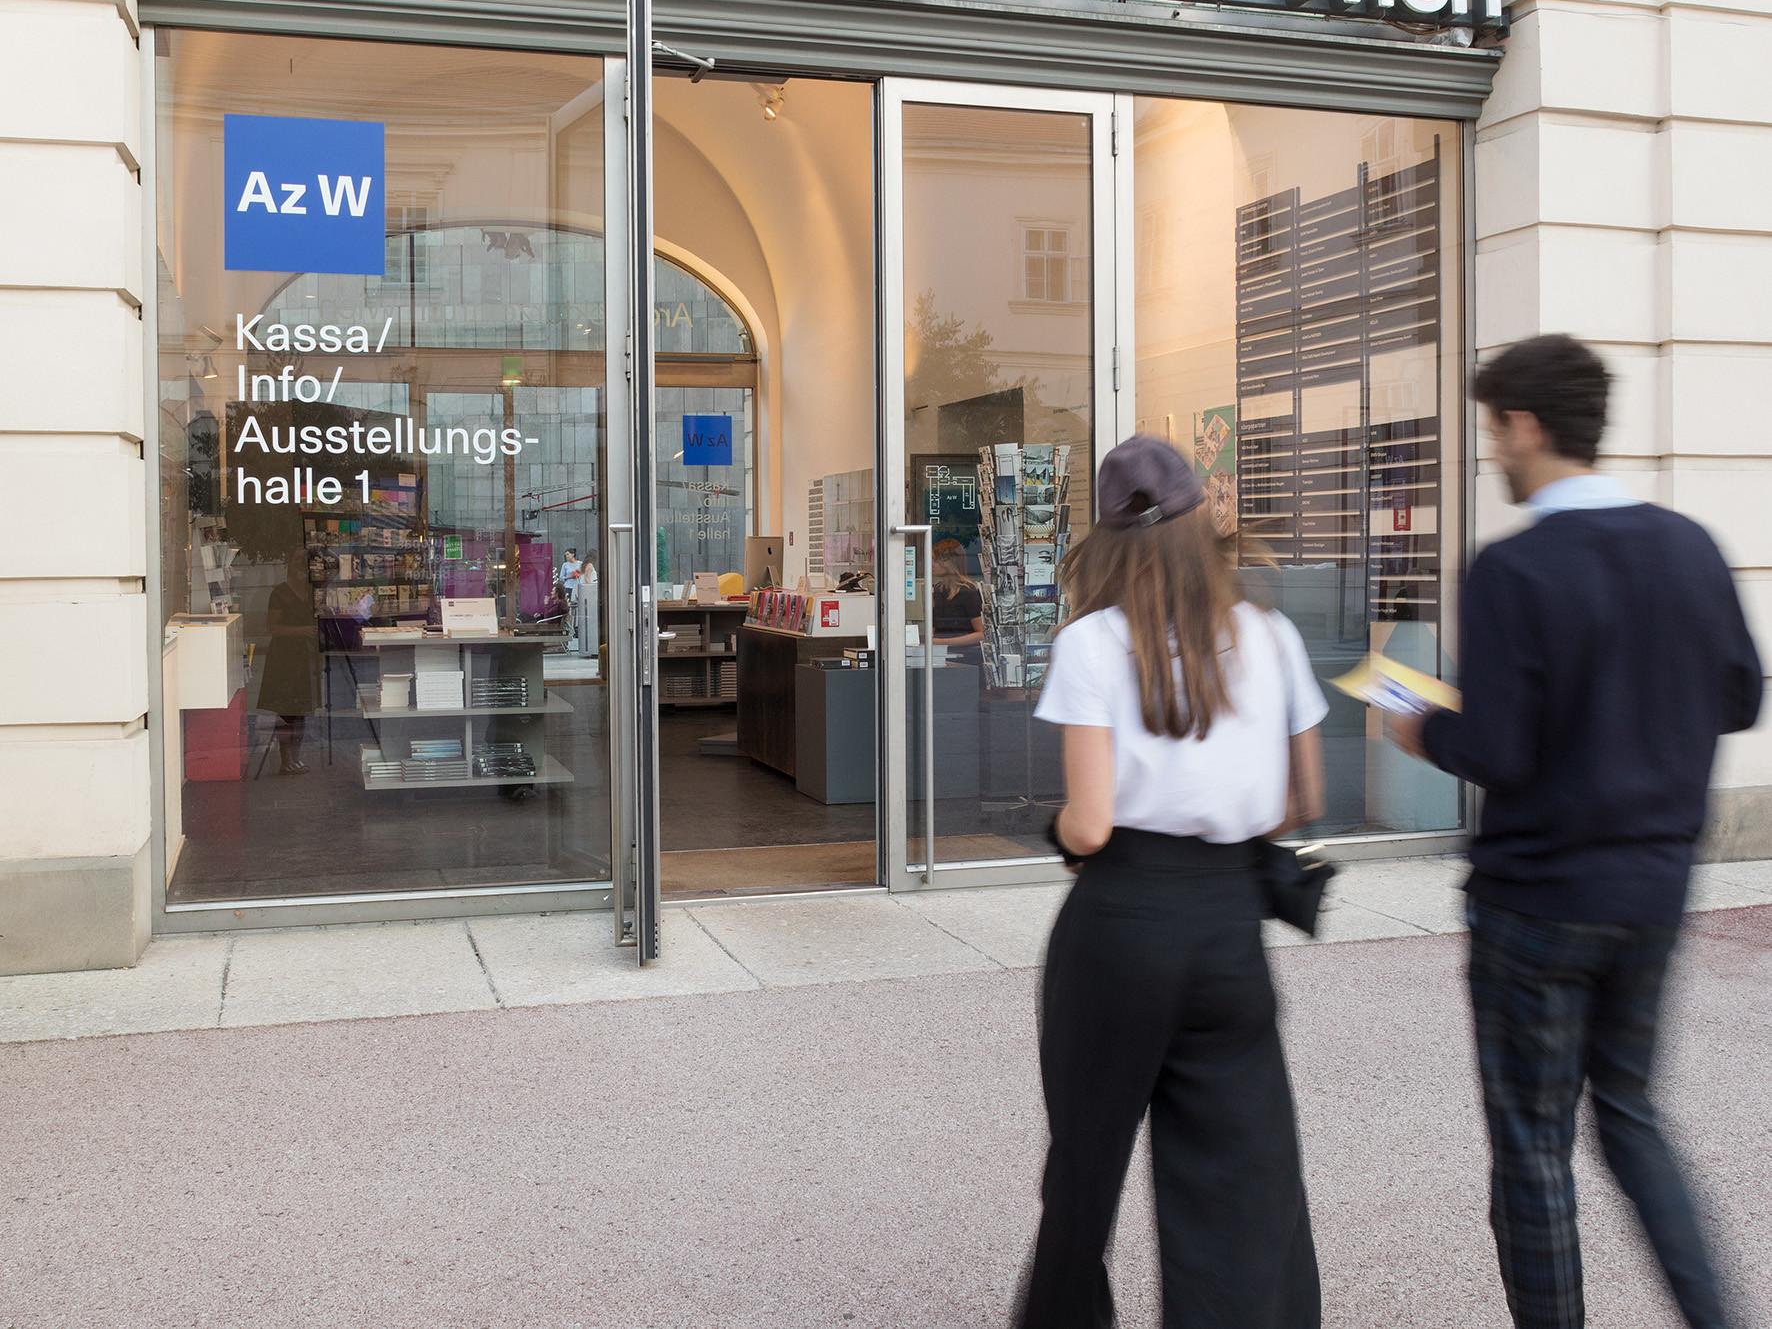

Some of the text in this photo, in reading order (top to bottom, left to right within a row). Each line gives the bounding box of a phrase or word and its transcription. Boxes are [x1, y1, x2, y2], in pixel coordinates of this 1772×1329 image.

[236, 170, 372, 217] Az W
[235, 313, 393, 353] Kassa/
[238, 365, 344, 403] Info/
[234, 415, 540, 464] Ausstellungs-
[237, 467, 372, 505] halle 1
